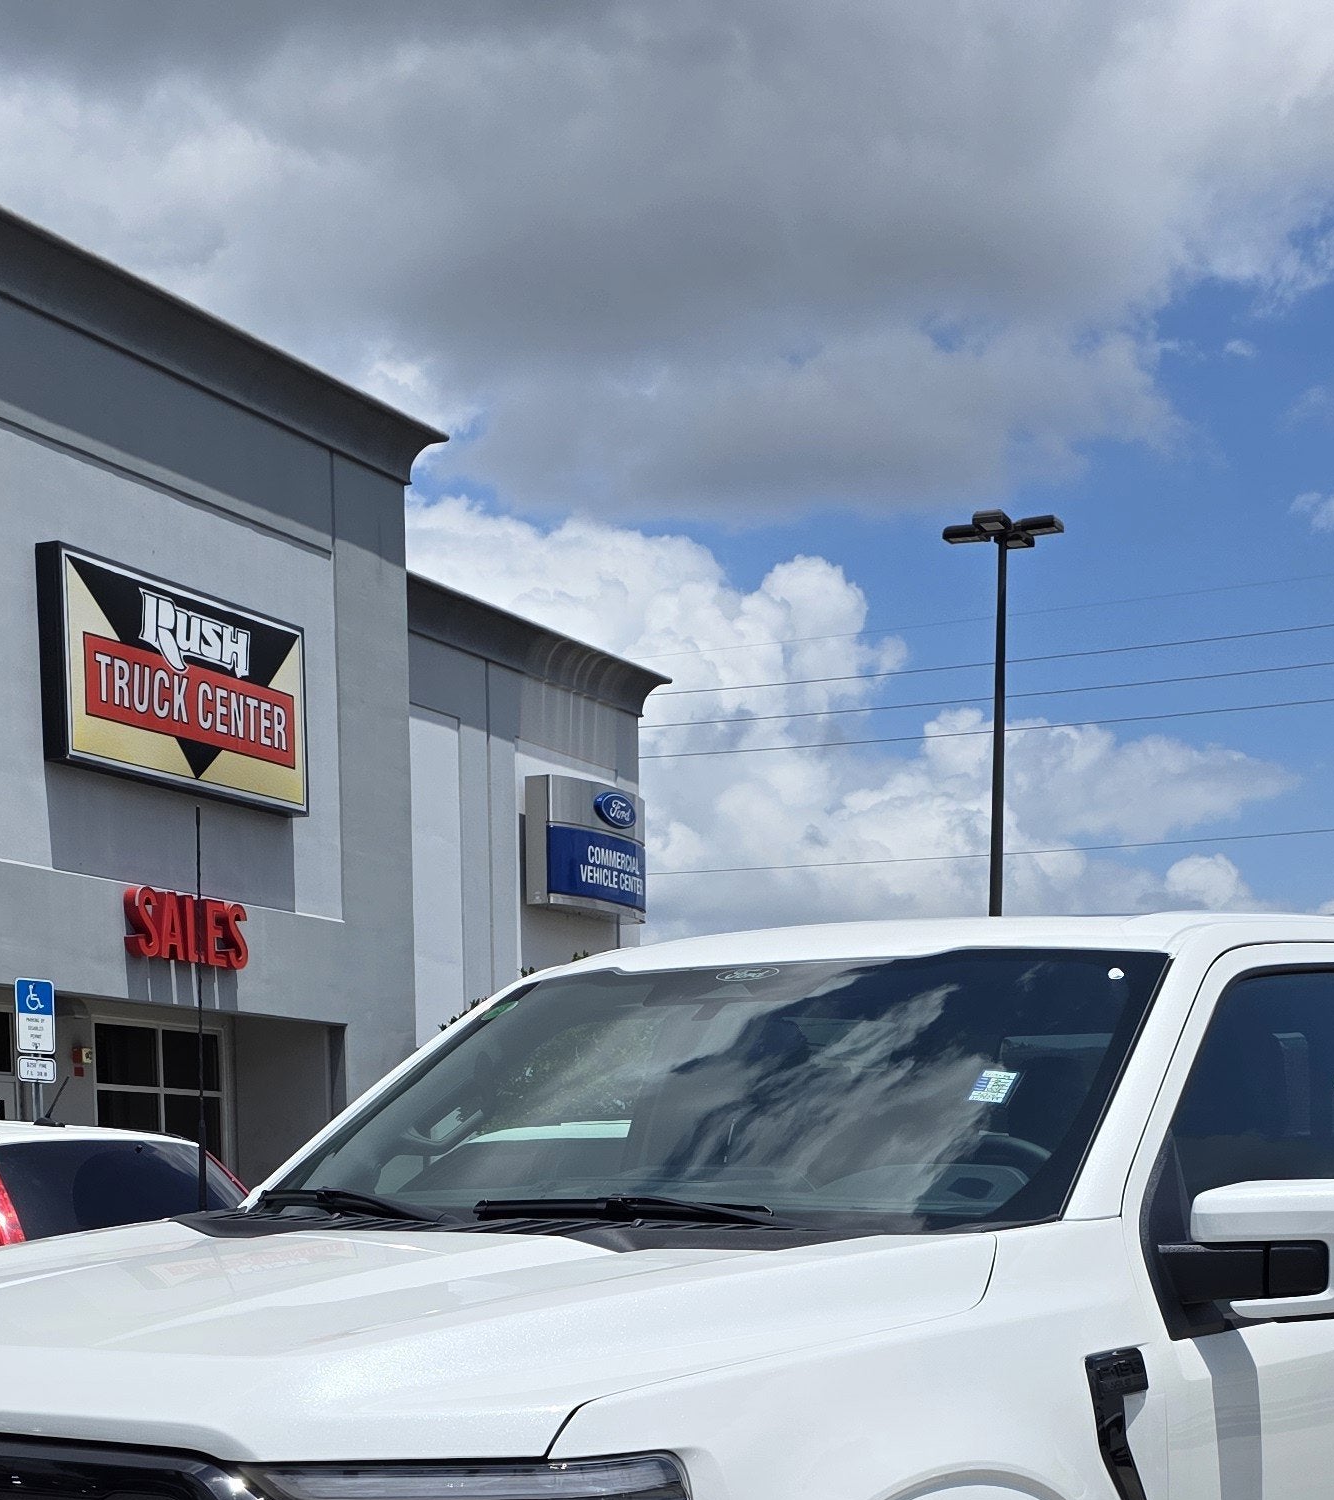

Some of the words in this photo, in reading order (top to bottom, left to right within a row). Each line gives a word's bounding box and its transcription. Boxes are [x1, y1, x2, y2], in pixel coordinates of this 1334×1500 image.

[94, 651, 189, 724] TRUCK
[197, 680, 288, 752] CENTER
[609, 799, 632, 822] Ford
[587, 845, 640, 875] COMMERCIAL
[580, 864, 618, 889] VEHICLE
[619, 872, 644, 896] CENTER
[124, 886, 249, 971] SALES
